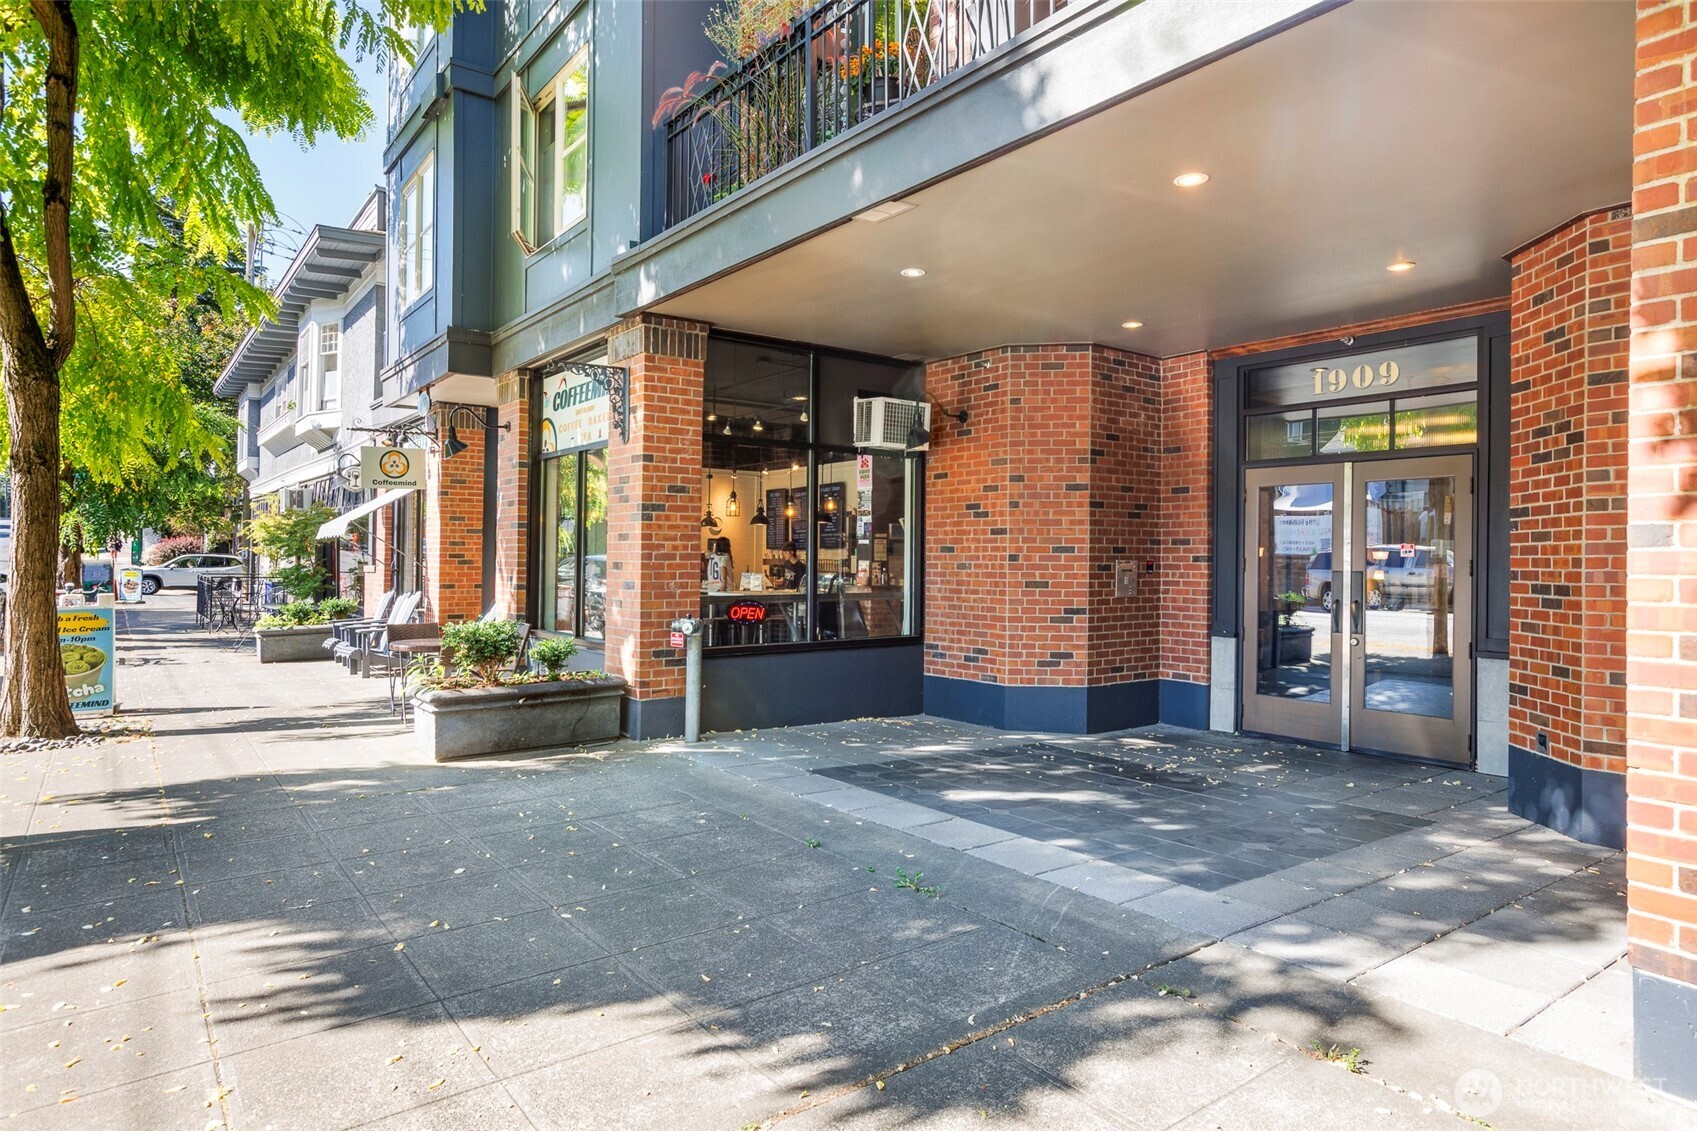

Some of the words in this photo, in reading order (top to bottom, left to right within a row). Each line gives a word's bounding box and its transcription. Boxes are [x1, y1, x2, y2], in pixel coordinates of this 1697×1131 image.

[1313, 361, 1400, 395] 1909
[558, 419, 582, 433] COFFEE
[587, 412, 609, 426] BAKE
[372, 479, 417, 487] Coffeemind
[73, 614, 99, 622] Fresh
[730, 605, 765, 619] OPEN
